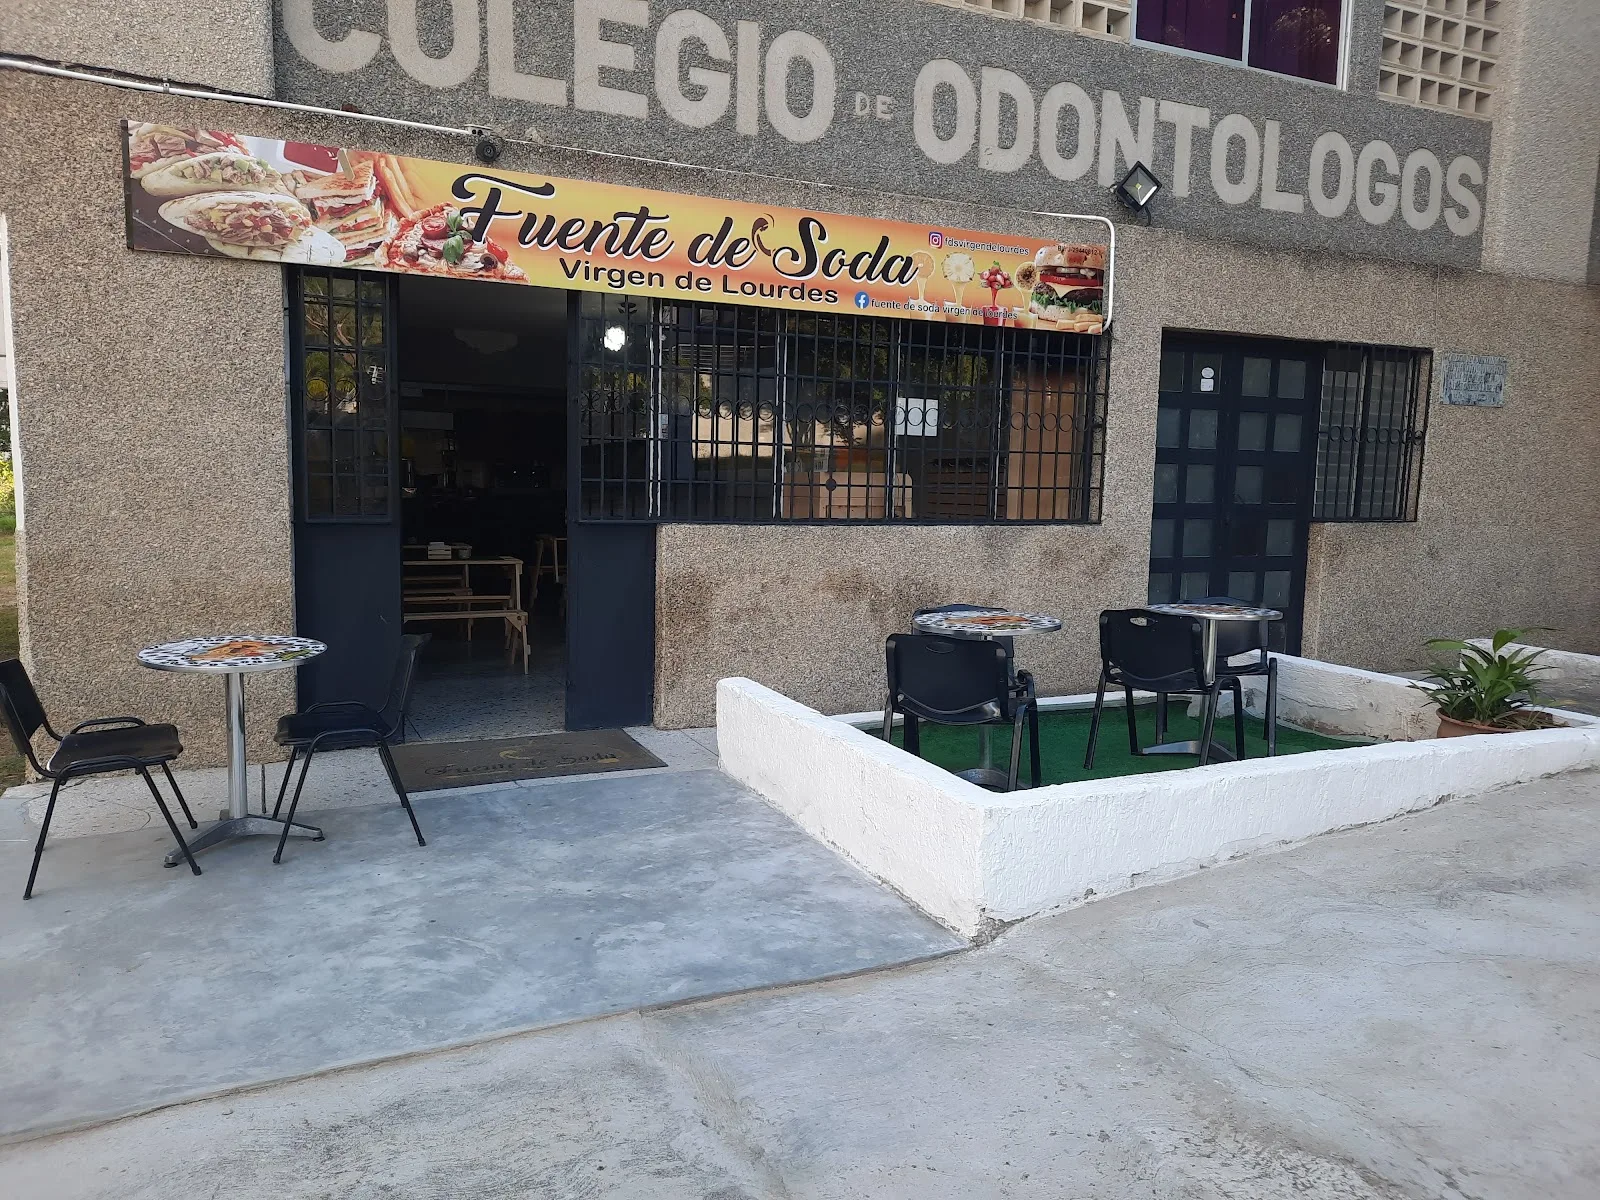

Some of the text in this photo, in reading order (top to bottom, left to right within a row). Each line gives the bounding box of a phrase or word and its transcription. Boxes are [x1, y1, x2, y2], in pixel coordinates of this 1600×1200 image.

[855, 91, 893, 120] DE
[913, 58, 1484, 237] ODONTOLOGOS
[451, 173, 921, 286] Fuente de Soda
[944, 237, 1029, 256] fdsvirgendelourdes
[559, 257, 839, 305] Virgen de Lourdes
[871, 299, 1018, 320] fuente de soda virgen de lourdes
